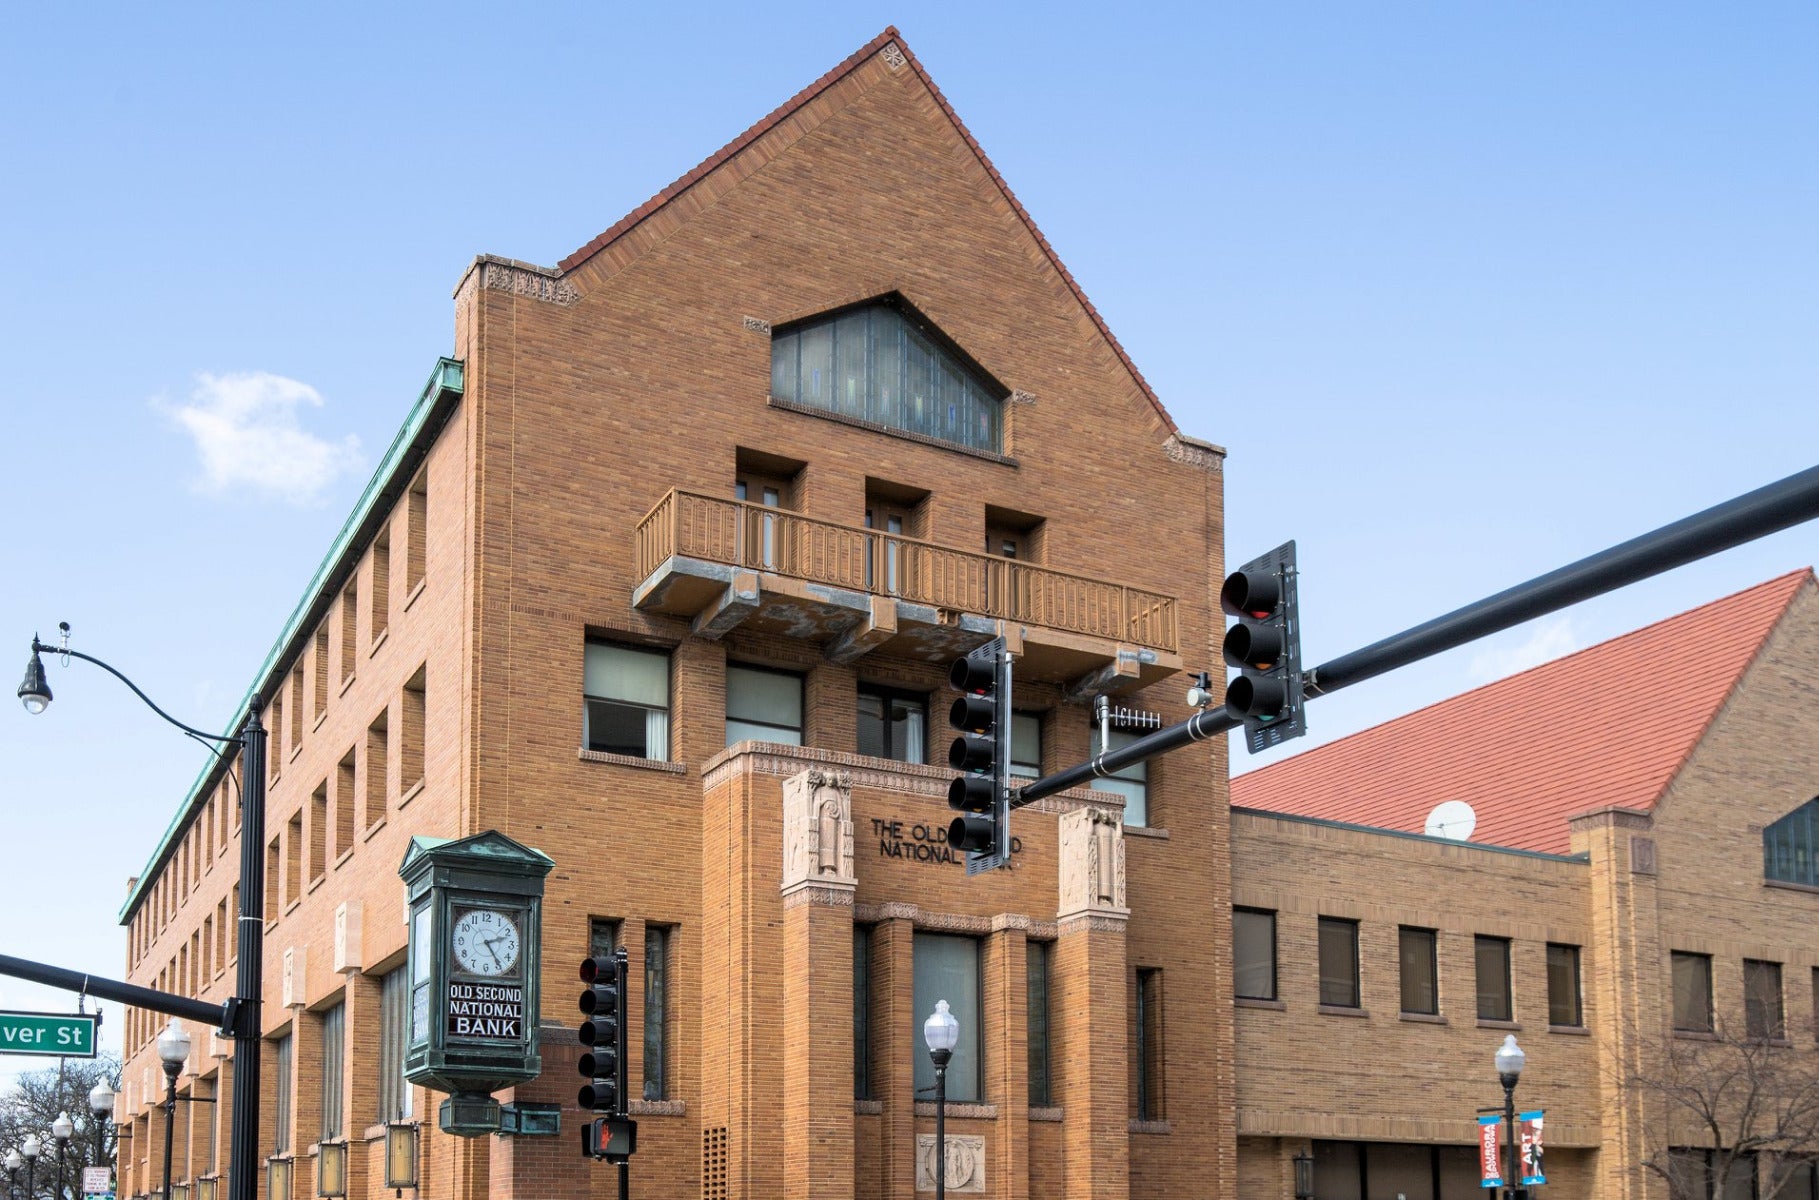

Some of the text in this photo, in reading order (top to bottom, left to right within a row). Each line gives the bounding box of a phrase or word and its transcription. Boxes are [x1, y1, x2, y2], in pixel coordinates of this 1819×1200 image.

[871, 818, 949, 844] THE OLD
[880, 839, 962, 865] NATIONAL
[472, 916, 477, 924] 11
[482, 913, 491, 922] 12
[462, 923, 470, 932] 10
[505, 928, 511, 936] 2
[458, 937, 464, 945] 9
[508, 941, 514, 950] 3
[461, 949, 467, 958] 8
[504, 952, 511, 962] 4
[471, 959, 476, 968] 7
[483, 963, 489, 972] 6
[450, 985, 521, 1002] OLD SECOND
[450, 1001, 521, 1018] NATIONAL
[457, 1017, 516, 1036] BANK
[57, 1026, 82, 1045] St
[1484, 1125, 1493, 1172] AURORA
[1521, 1133, 1533, 1165] ART
